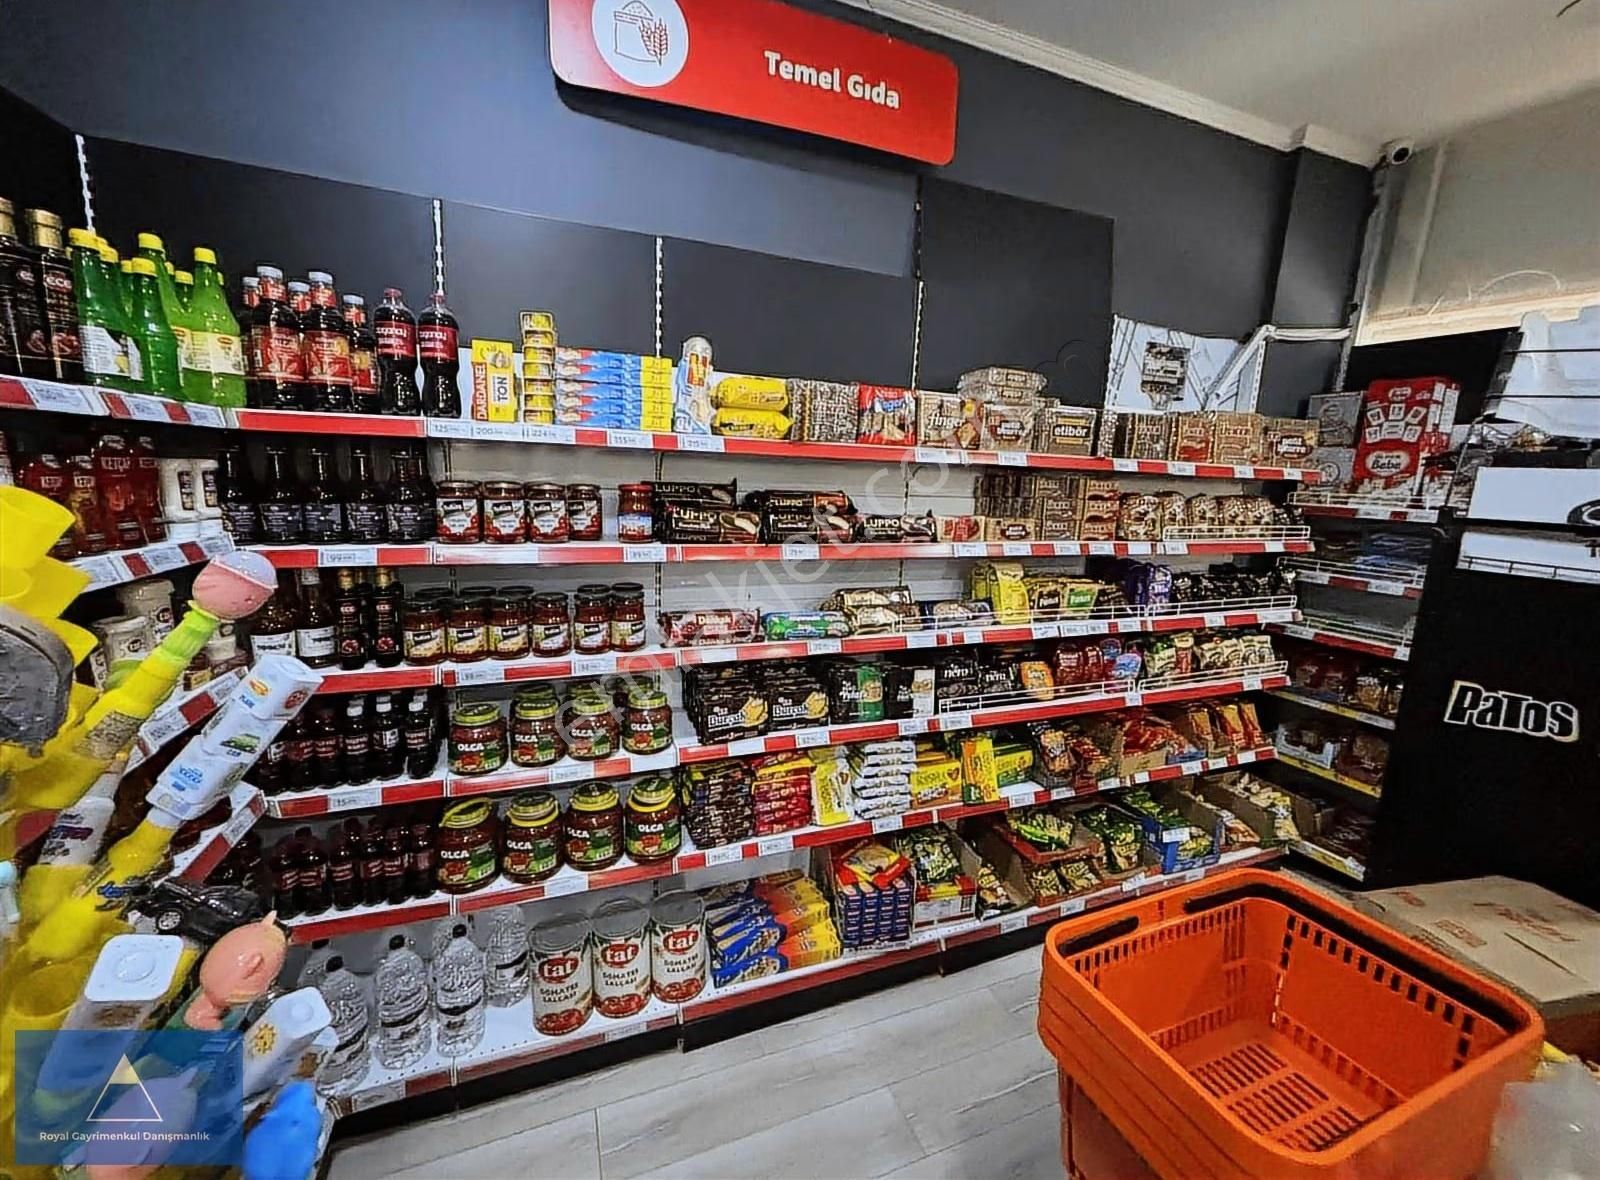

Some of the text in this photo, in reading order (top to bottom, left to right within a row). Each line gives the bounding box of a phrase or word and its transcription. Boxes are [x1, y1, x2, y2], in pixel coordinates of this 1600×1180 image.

[763, 50, 900, 109] Temel Gıda
[496, 376, 508, 402] TON
[928, 412, 966, 430] finger
[863, 518, 900, 528] LUPPO
[667, 932, 698, 948] tat
[605, 945, 637, 962] tat
[543, 958, 576, 979] tat
